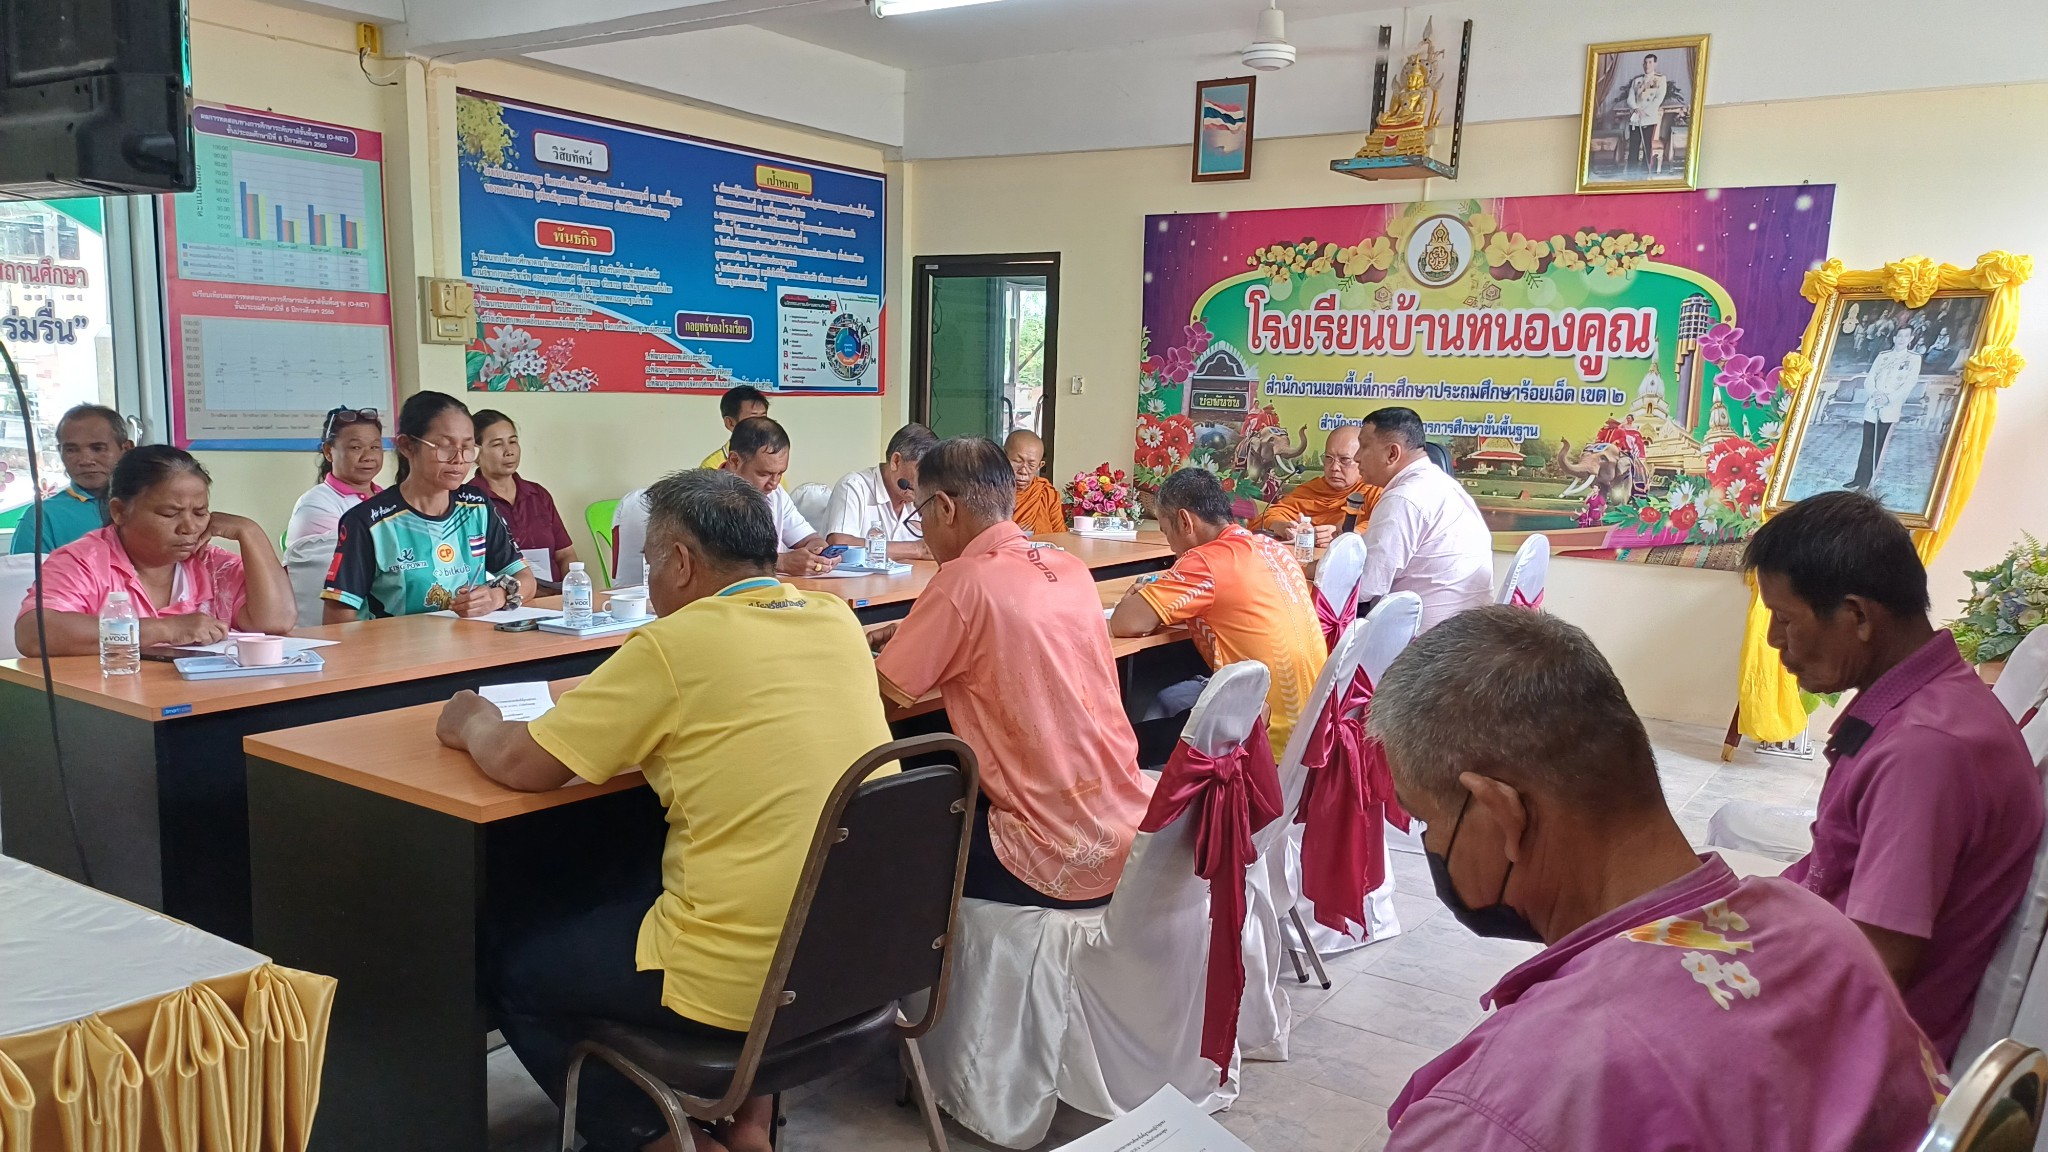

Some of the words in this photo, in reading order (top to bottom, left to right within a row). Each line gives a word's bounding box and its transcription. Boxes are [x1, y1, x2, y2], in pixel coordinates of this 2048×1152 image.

[326, 133, 349, 144] (O-NET)
[552, 145, 593, 166] วิสัยทัศน์
[553, 227, 598, 247] พันธกิจ
[0, 257, 87, 287] ถานศึกษา
[1248, 290, 1652, 376] โรงเรียนบ้านหนองคูณ
[1266, 371, 1575, 401] สำนักงานเขตพื้นที่การศึกษาประถมศึกษาร้อยเอ็ด
[1580, 387, 1606, 403] เขต
[1612, 389, 1624, 403] ๒
[439, 548, 452, 558] CP
[444, 565, 470, 576] bitkub
